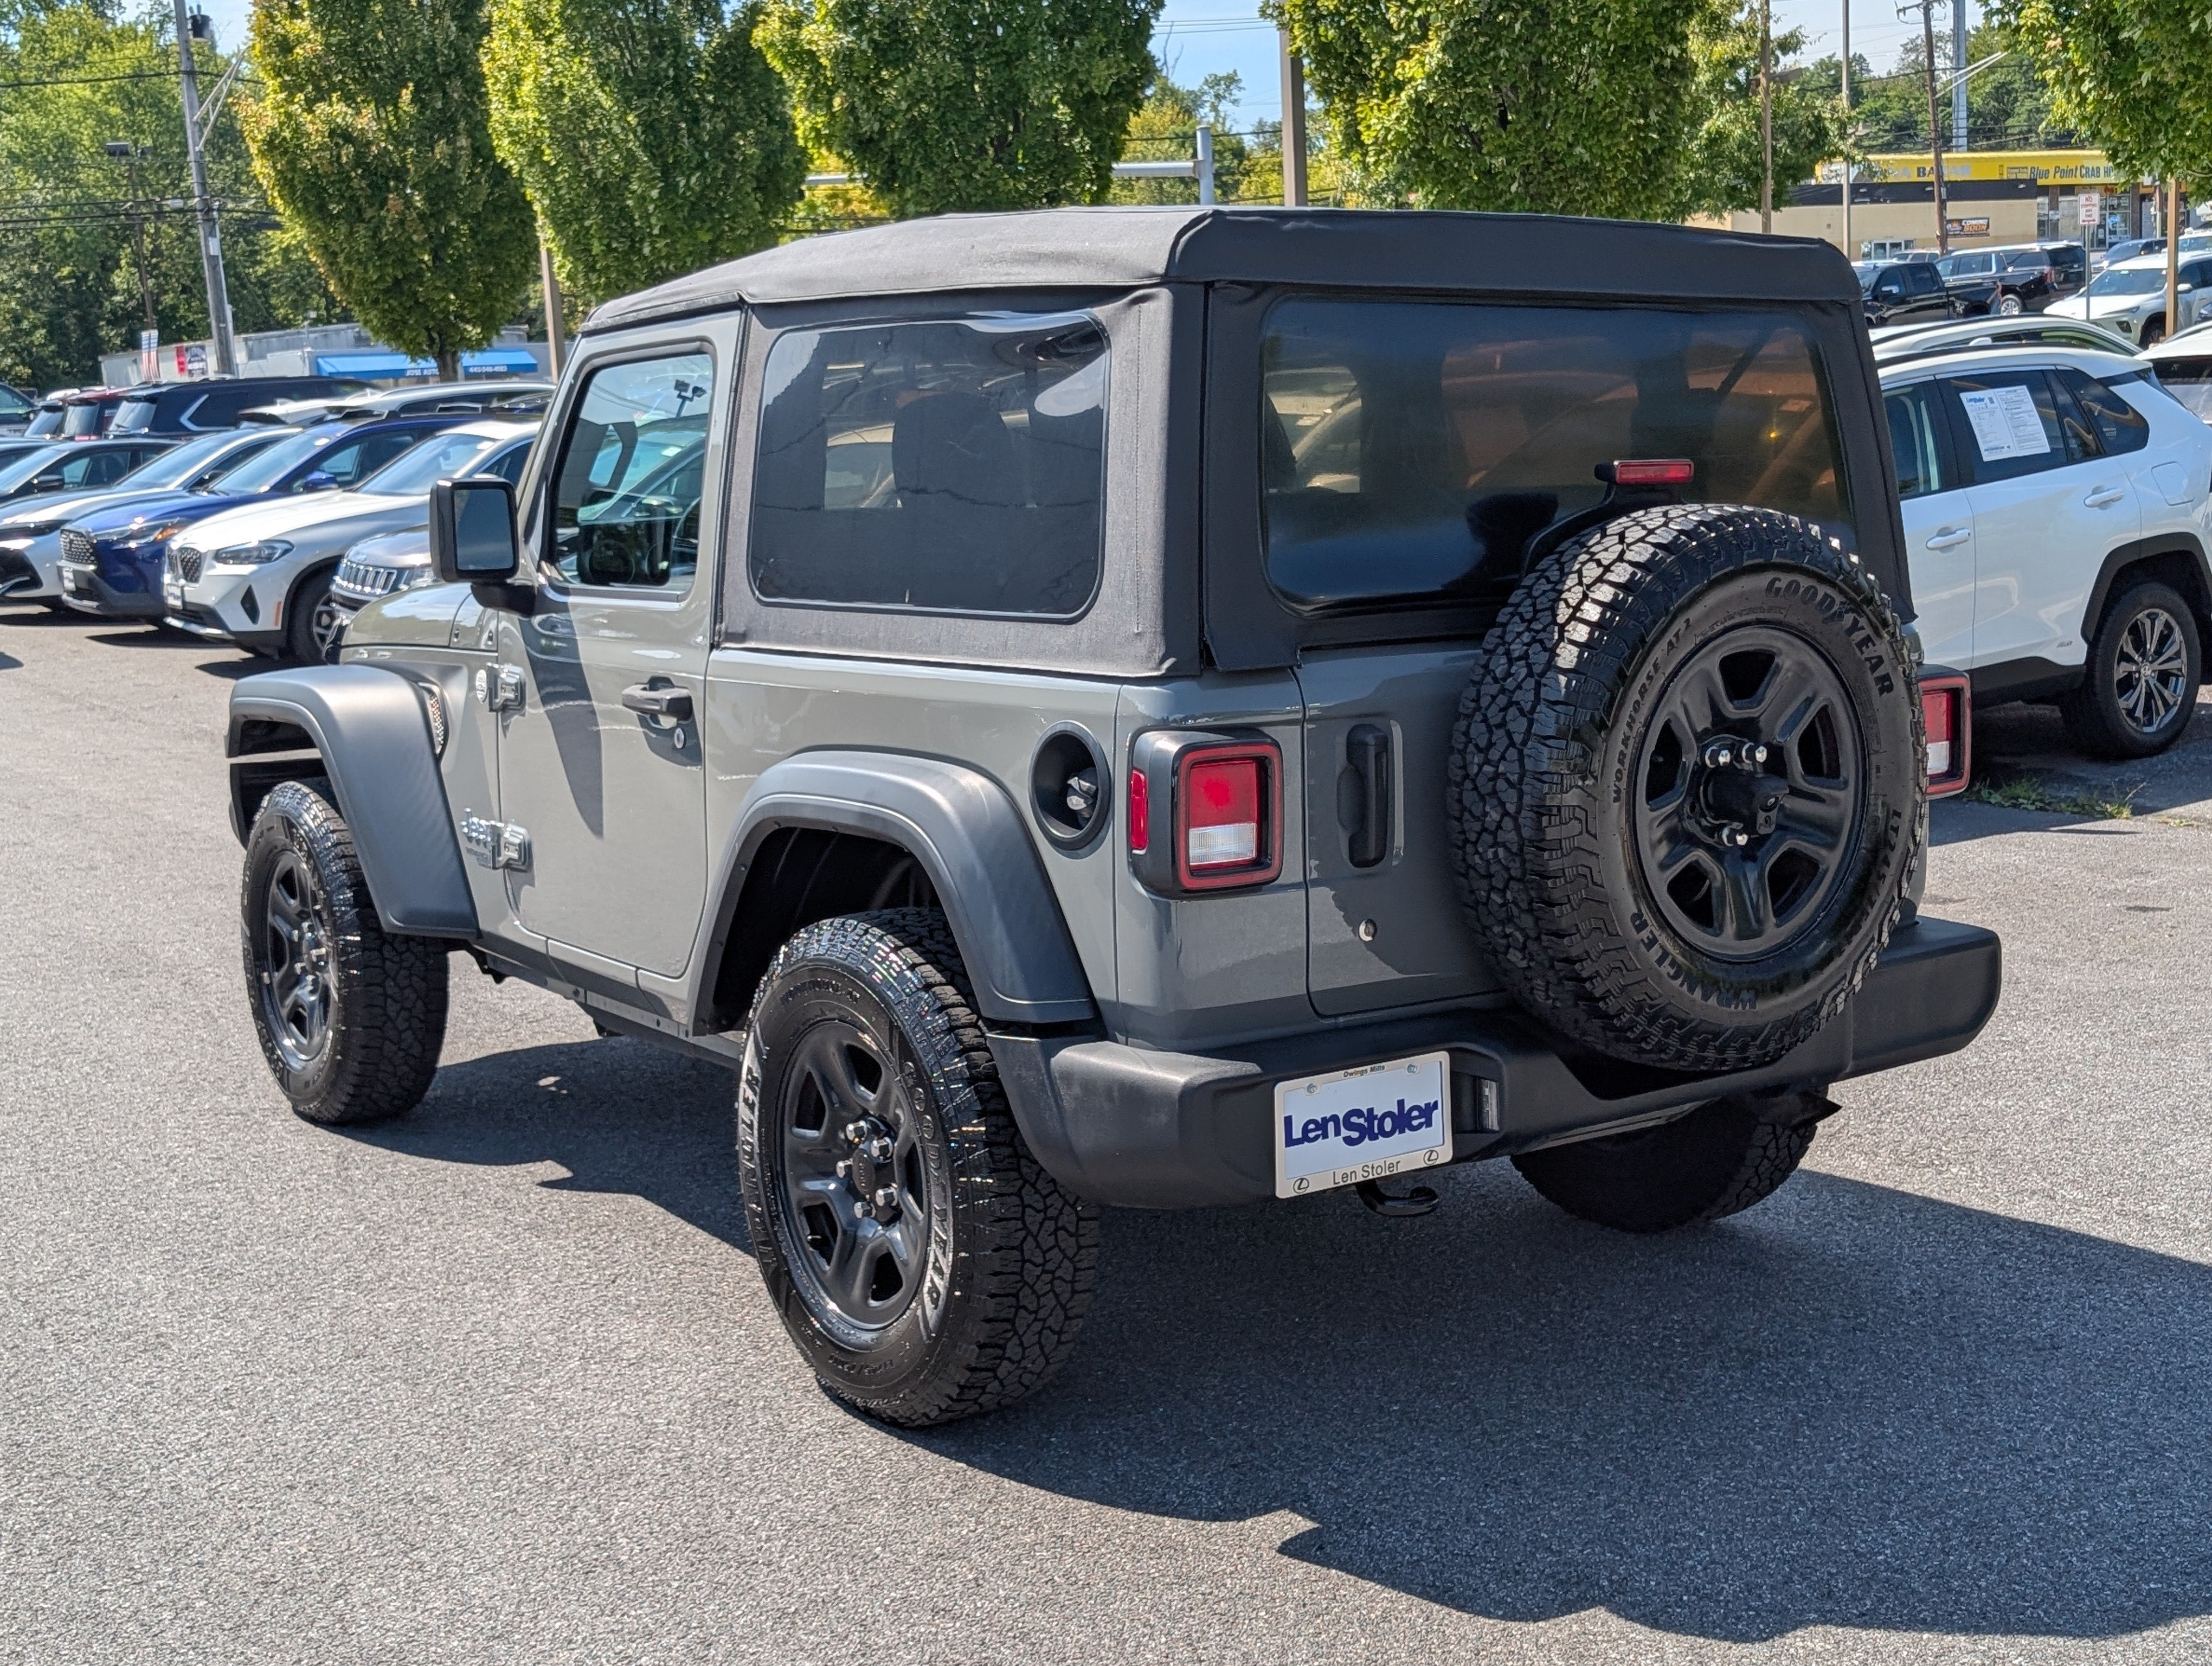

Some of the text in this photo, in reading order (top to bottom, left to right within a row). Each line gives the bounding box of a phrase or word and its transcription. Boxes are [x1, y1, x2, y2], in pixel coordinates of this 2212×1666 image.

[2030, 166, 2050, 180] Blue
[2053, 165, 2078, 179] Point
[2080, 165, 2100, 178] CRAB
[1765, 577, 1894, 697] GOODYEAR
[1613, 656, 1660, 804] WORKHORSE
[1630, 907, 1757, 1010] WRANGLER
[1333, 1160, 1401, 1186] Len Stoler
